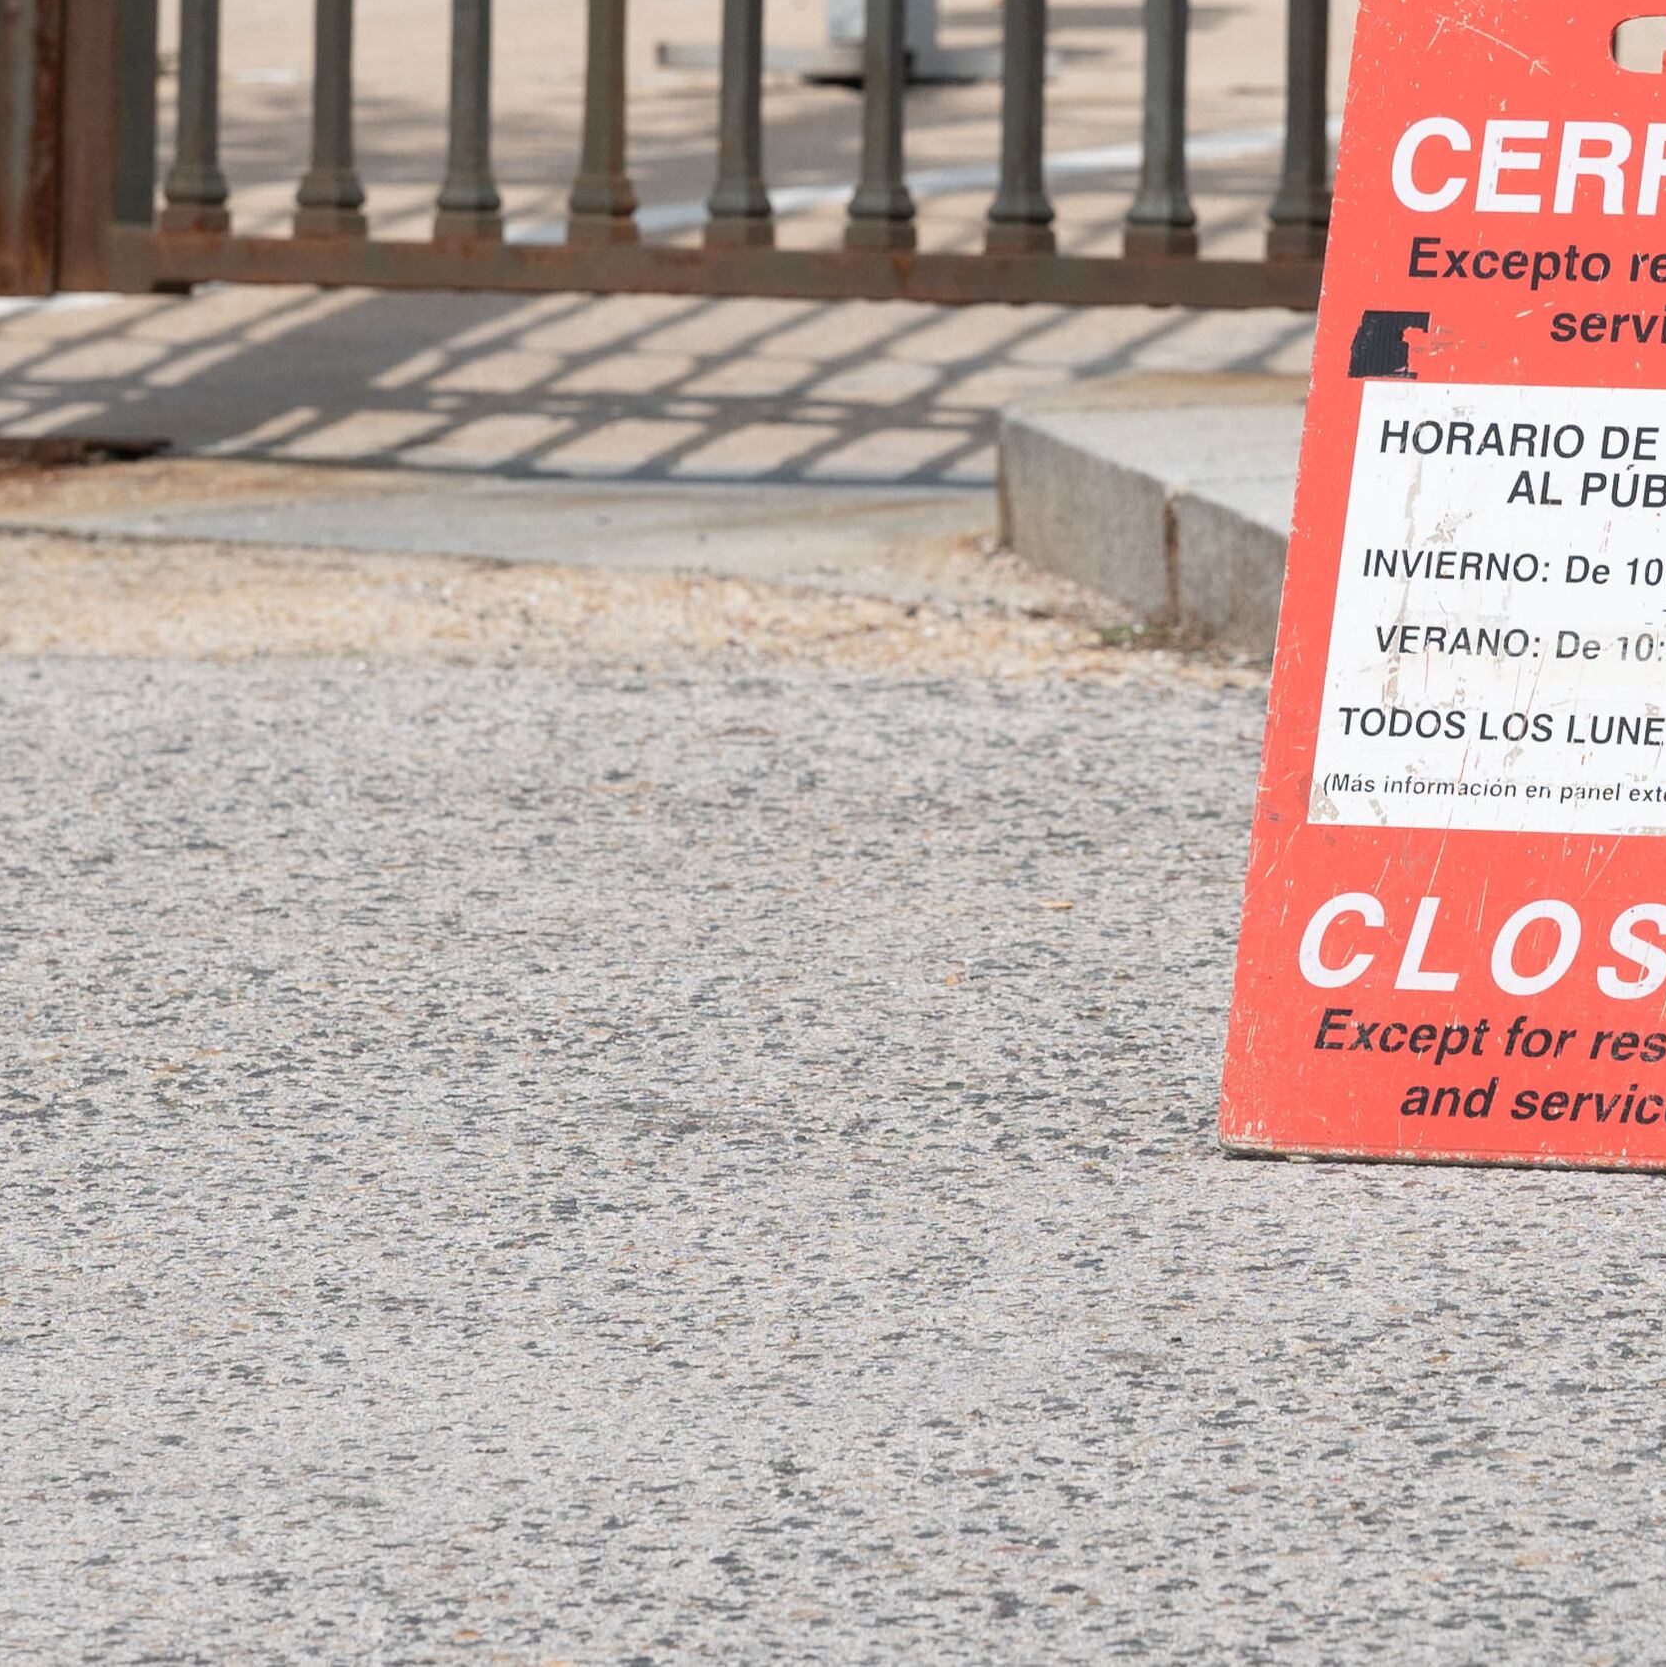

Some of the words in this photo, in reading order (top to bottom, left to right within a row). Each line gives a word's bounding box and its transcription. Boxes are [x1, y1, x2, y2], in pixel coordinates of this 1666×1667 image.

[1409, 238, 1612, 291] Excepto
[1380, 421, 1585, 461] HORARIO
[1601, 427, 1657, 460] DE
[1507, 471, 1562, 505] AL
[1363, 549, 1550, 582] INVIERNO:
[1565, 556, 1610, 585] De
[1376, 626, 1540, 658] VERANO:
[1556, 631, 1601, 659] De
[1339, 707, 1466, 740] TODOS
[1479, 712, 1553, 742] LOS
[1323, 774, 1375, 796] (Más
[1384, 776, 1516, 798] información
[1526, 786, 1551, 799] en
[1560, 783, 1620, 803] panel
[1314, 1008, 1489, 1065] Except
[1504, 1013, 1575, 1058] for
[1400, 1076, 1498, 1120] and
